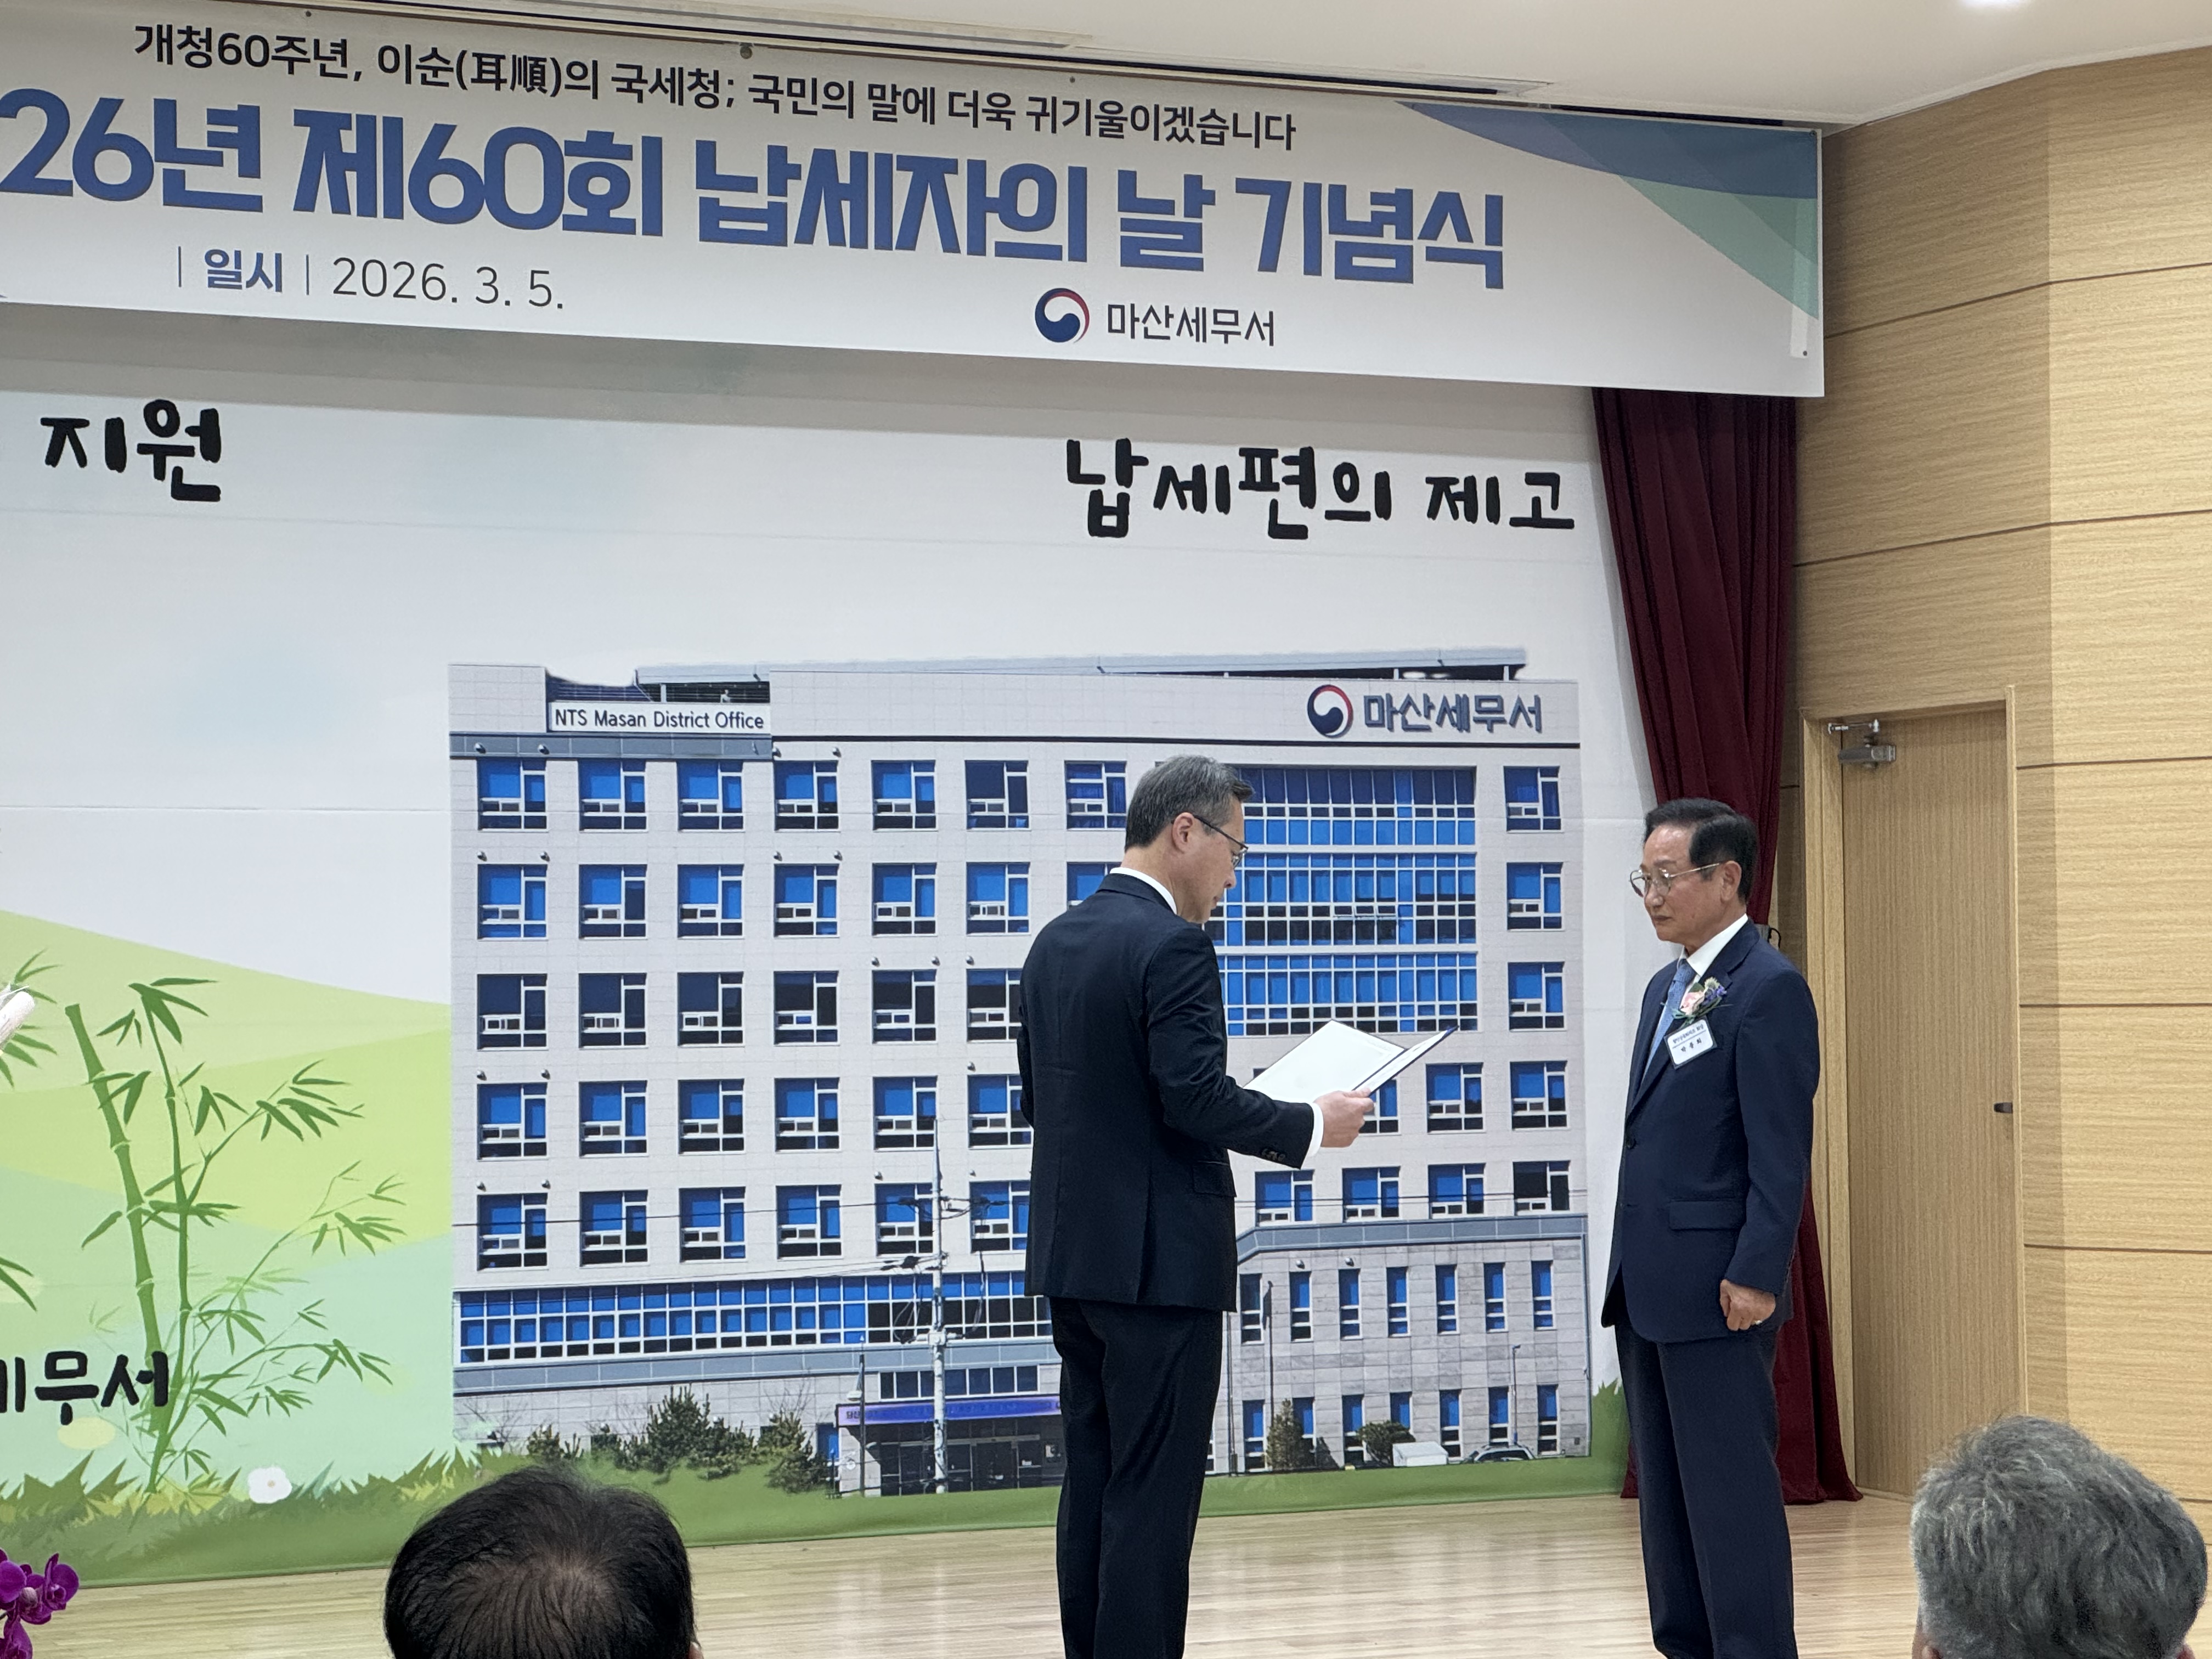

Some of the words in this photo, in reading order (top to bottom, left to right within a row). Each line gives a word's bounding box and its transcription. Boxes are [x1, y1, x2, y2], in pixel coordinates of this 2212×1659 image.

[135, 25, 362, 81] 개청60주년,
[379, 44, 598, 99] 이순(耳順)의
[612, 64, 733, 109] 국세청;
[748, 75, 854, 119] 국민의
[868, 84, 935, 125] 말에
[949, 90, 1015, 131] 더욱
[1026, 97, 1296, 150] 귀기울이겠습니다
[293, 109, 663, 236] 제60회
[696, 140, 1087, 262] 납세자의
[1118, 170, 1216, 272] 날
[1235, 178, 1503, 289] 기념식
[205, 250, 282, 292] 일시
[334, 258, 457, 302] 2026.
[476, 267, 510, 306] 3.
[529, 270, 562, 309] 5.
[1108, 303, 1273, 346] 마산세무서
[41, 399, 221, 502] 지원
[1066, 438, 1391, 540] 납세편의
[1425, 472, 1575, 529] 제고
[556, 709, 587, 726] NTS
[595, 710, 646, 727] Masan
[654, 710, 709, 727] District
[715, 712, 764, 729] Office
[1364, 693, 1542, 733] 마산세무서
